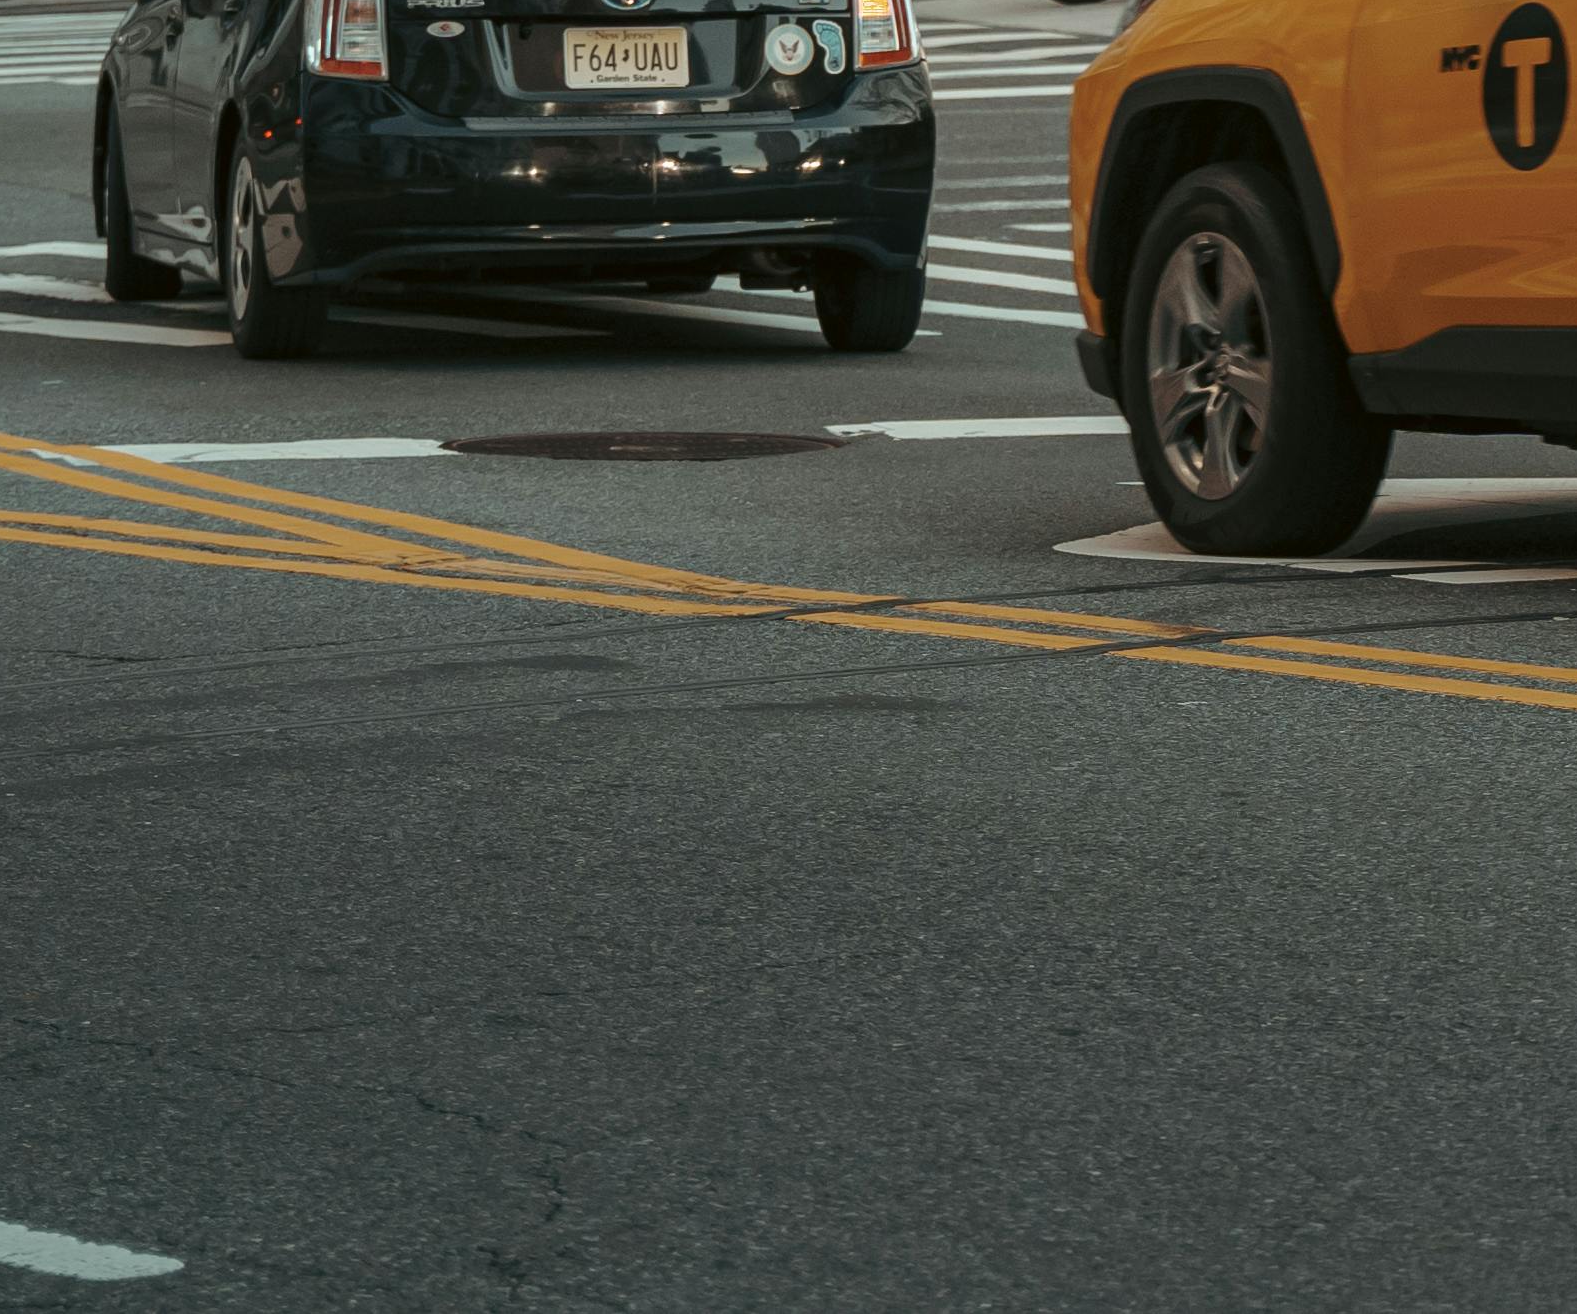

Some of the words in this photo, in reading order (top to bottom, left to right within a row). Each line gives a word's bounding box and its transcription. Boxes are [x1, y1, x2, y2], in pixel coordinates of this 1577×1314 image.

[596, 74, 630, 83] Garden
[633, 74, 658, 82] State
[1501, 36, 1553, 148] T
